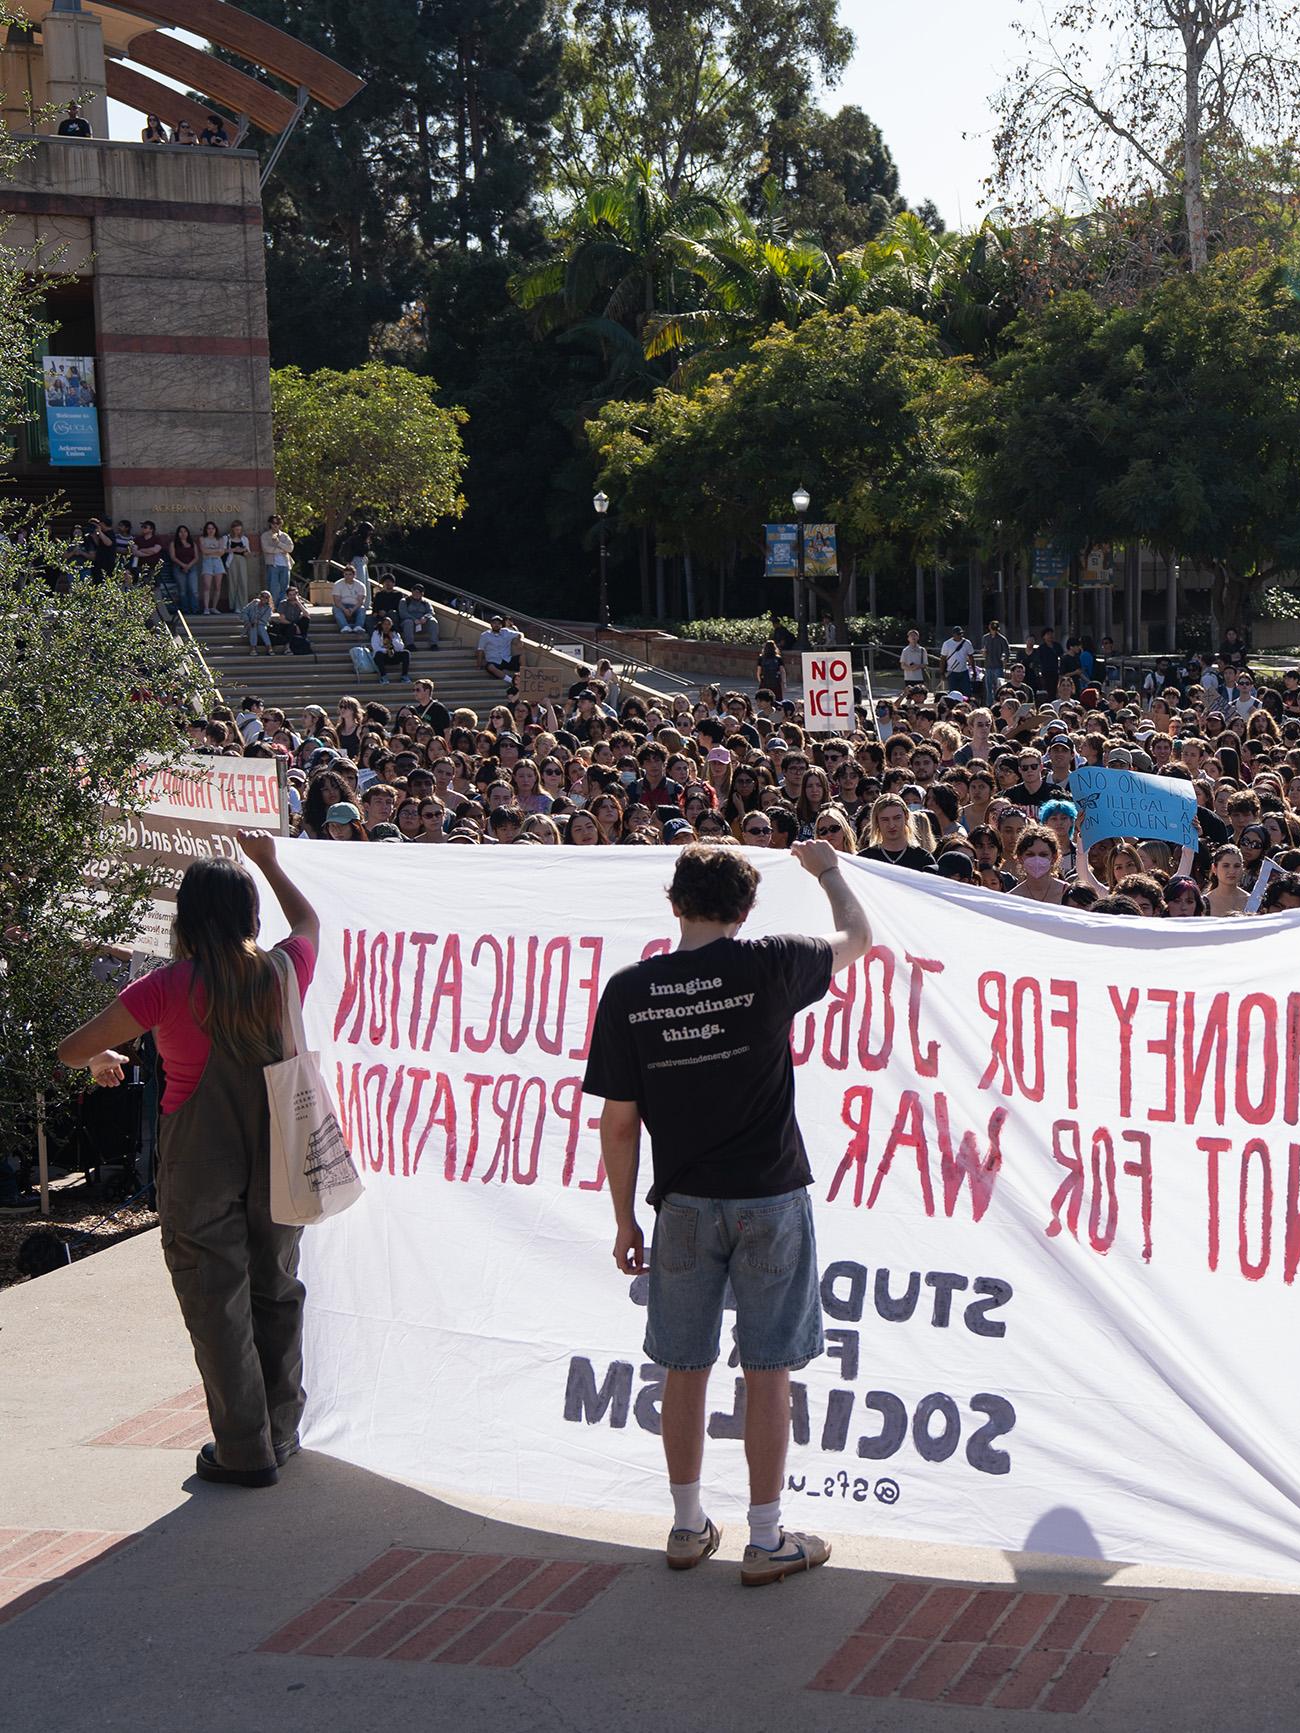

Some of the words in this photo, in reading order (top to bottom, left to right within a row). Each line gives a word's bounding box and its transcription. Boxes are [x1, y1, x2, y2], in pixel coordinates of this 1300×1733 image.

[811, 659, 848, 682] NO
[809, 689, 849, 717] ICE
[1077, 771, 1107, 792] NO
[1106, 794, 1169, 813] ILLEGAL
[1111, 810, 1169, 831] STOLEN
[649, 976, 723, 997] imagine
[628, 992, 756, 1024] extraordinary
[661, 1023, 726, 1043] things.
